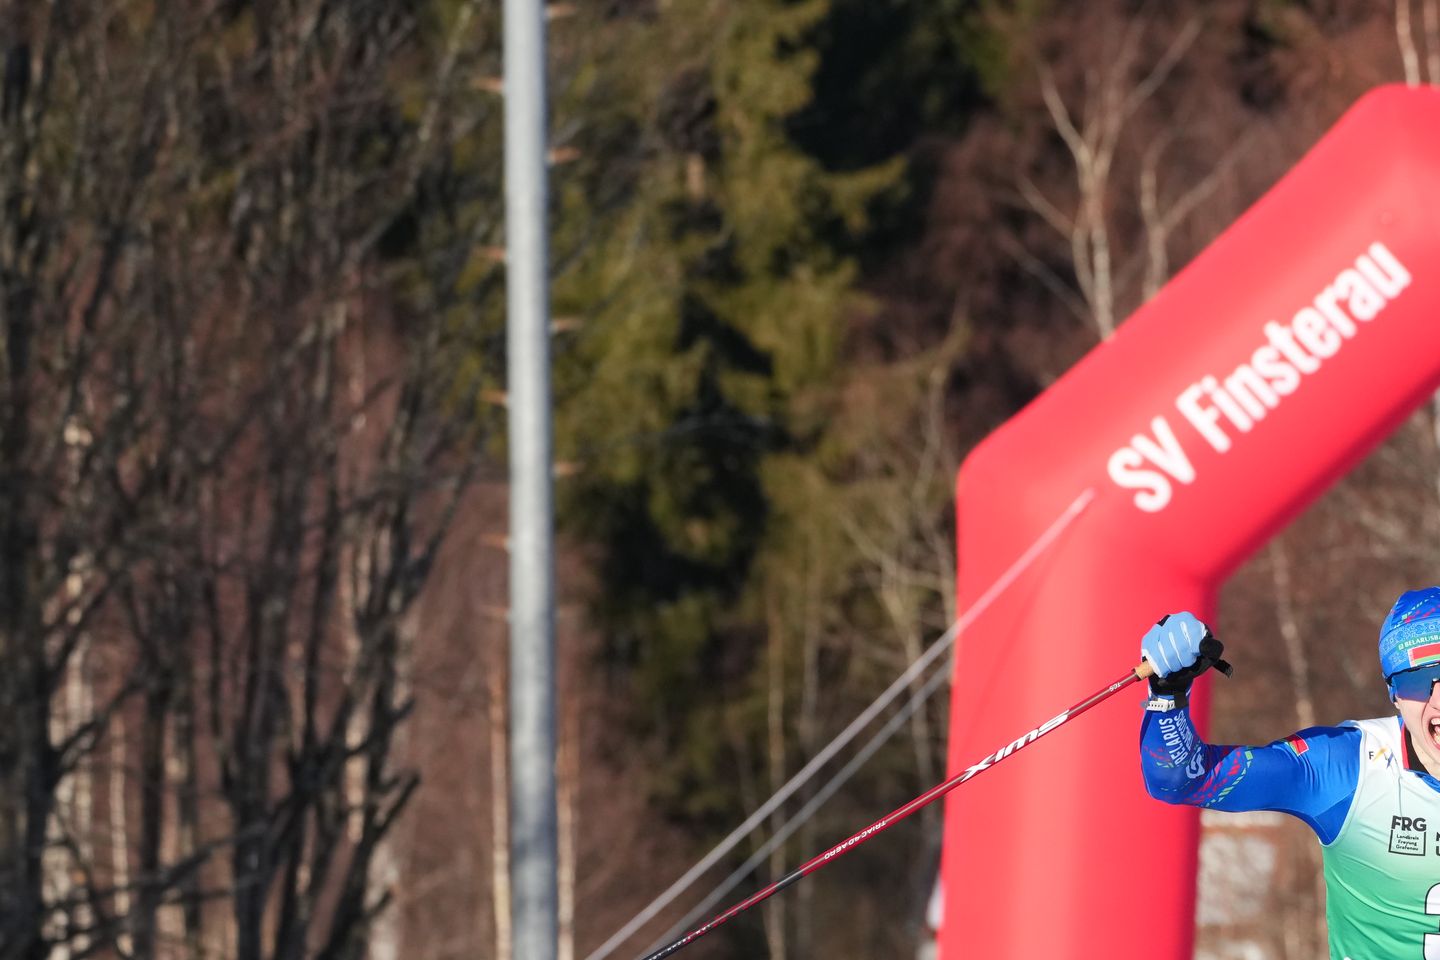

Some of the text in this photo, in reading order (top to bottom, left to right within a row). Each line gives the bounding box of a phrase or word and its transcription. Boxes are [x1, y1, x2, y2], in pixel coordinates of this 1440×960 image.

[1107, 241, 1412, 513] SV Finsterau
[961, 709, 1070, 783] SWIX
[1159, 717, 1187, 767] BELARUS
[861, 820, 886, 838] TRIAC
[1391, 815, 1427, 832] FRG
[824, 842, 848, 860] AERO
